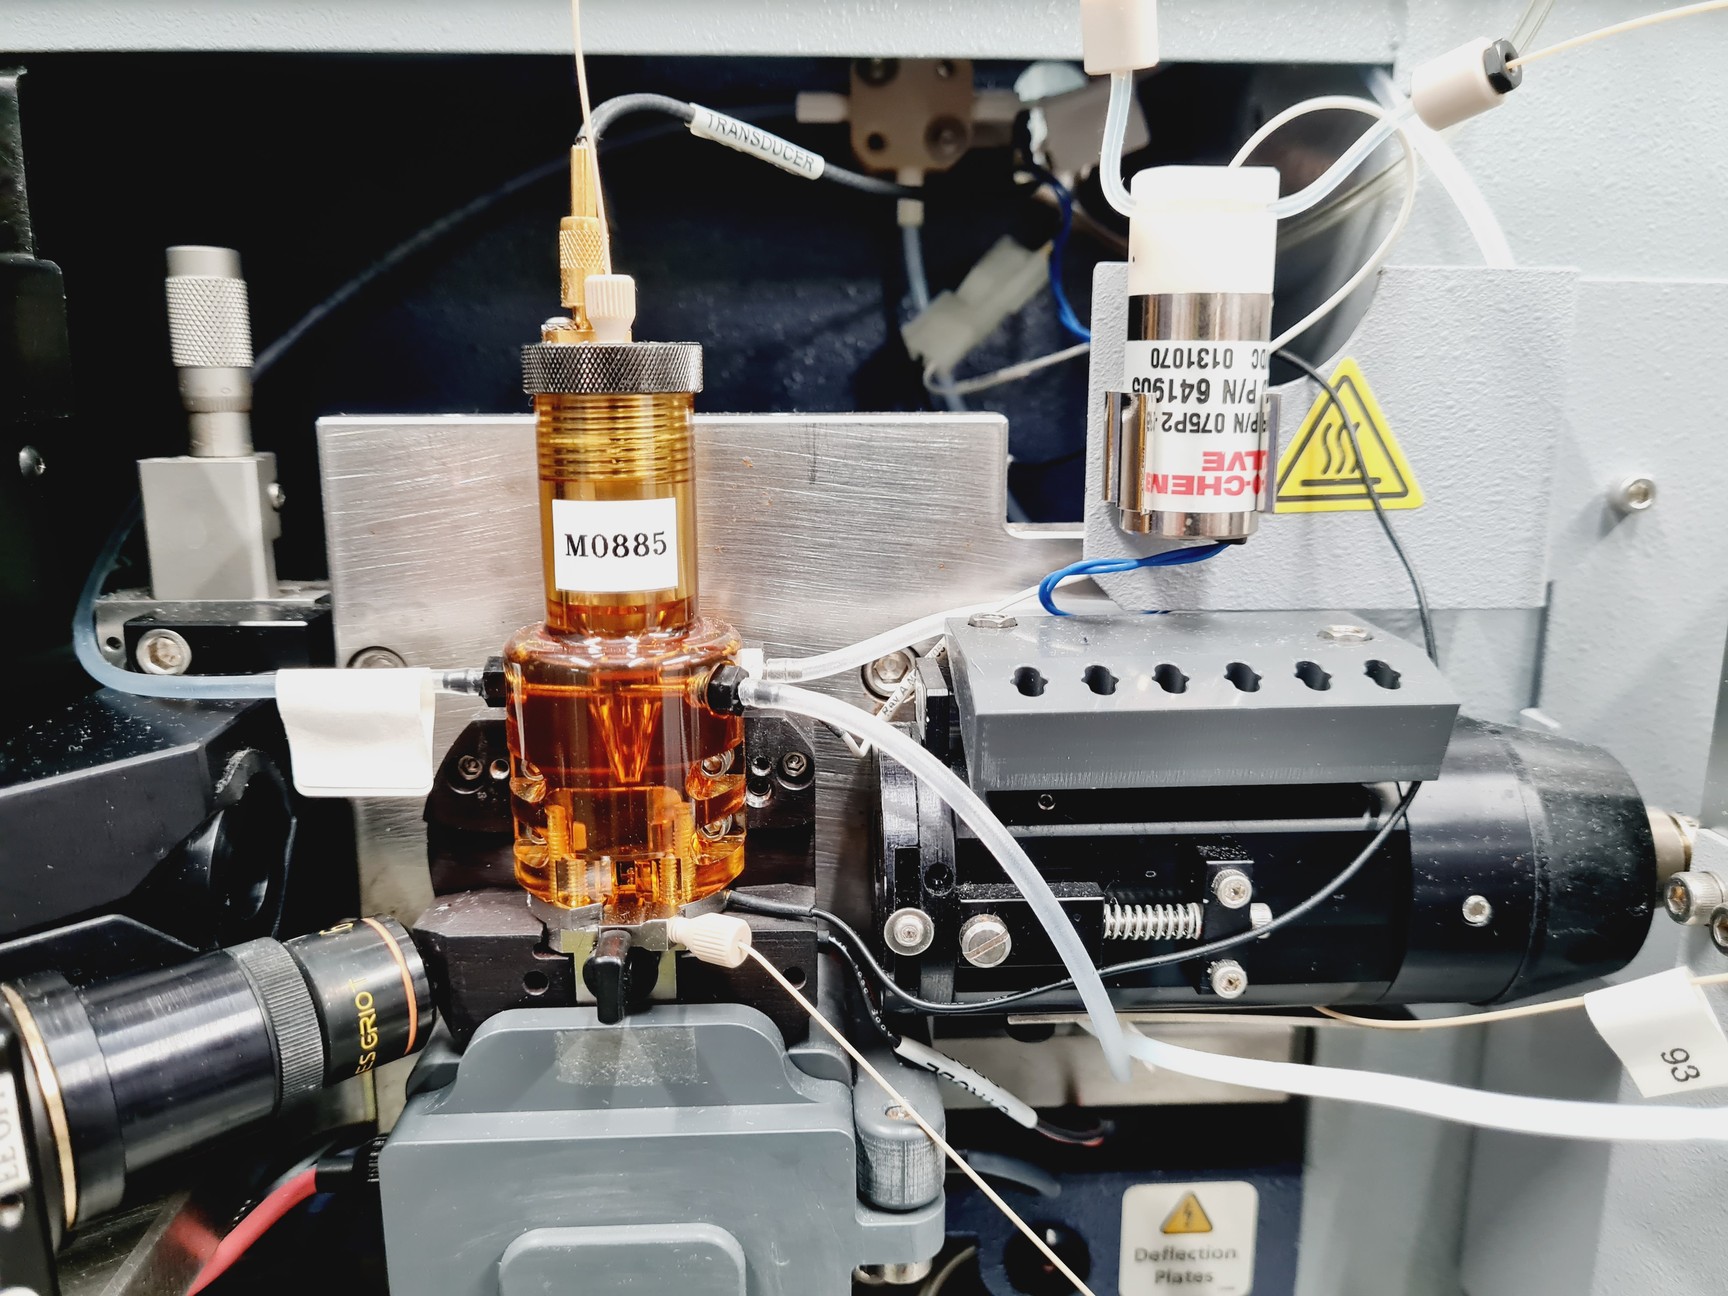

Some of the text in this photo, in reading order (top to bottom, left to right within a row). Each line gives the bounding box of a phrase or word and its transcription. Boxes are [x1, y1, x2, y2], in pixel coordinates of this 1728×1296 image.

[706, 112, 816, 172] TRANSDUCER
[1151, 348, 1234, 369] 0131070
[1223, 379, 1256, 404] P/N
[564, 531, 667, 558] M0885
[348, 978, 379, 1050] GRIOT
[1661, 1047, 1700, 1082] 93
[1133, 1246, 1238, 1263] Deflection
[1154, 1269, 1214, 1285] Plates
